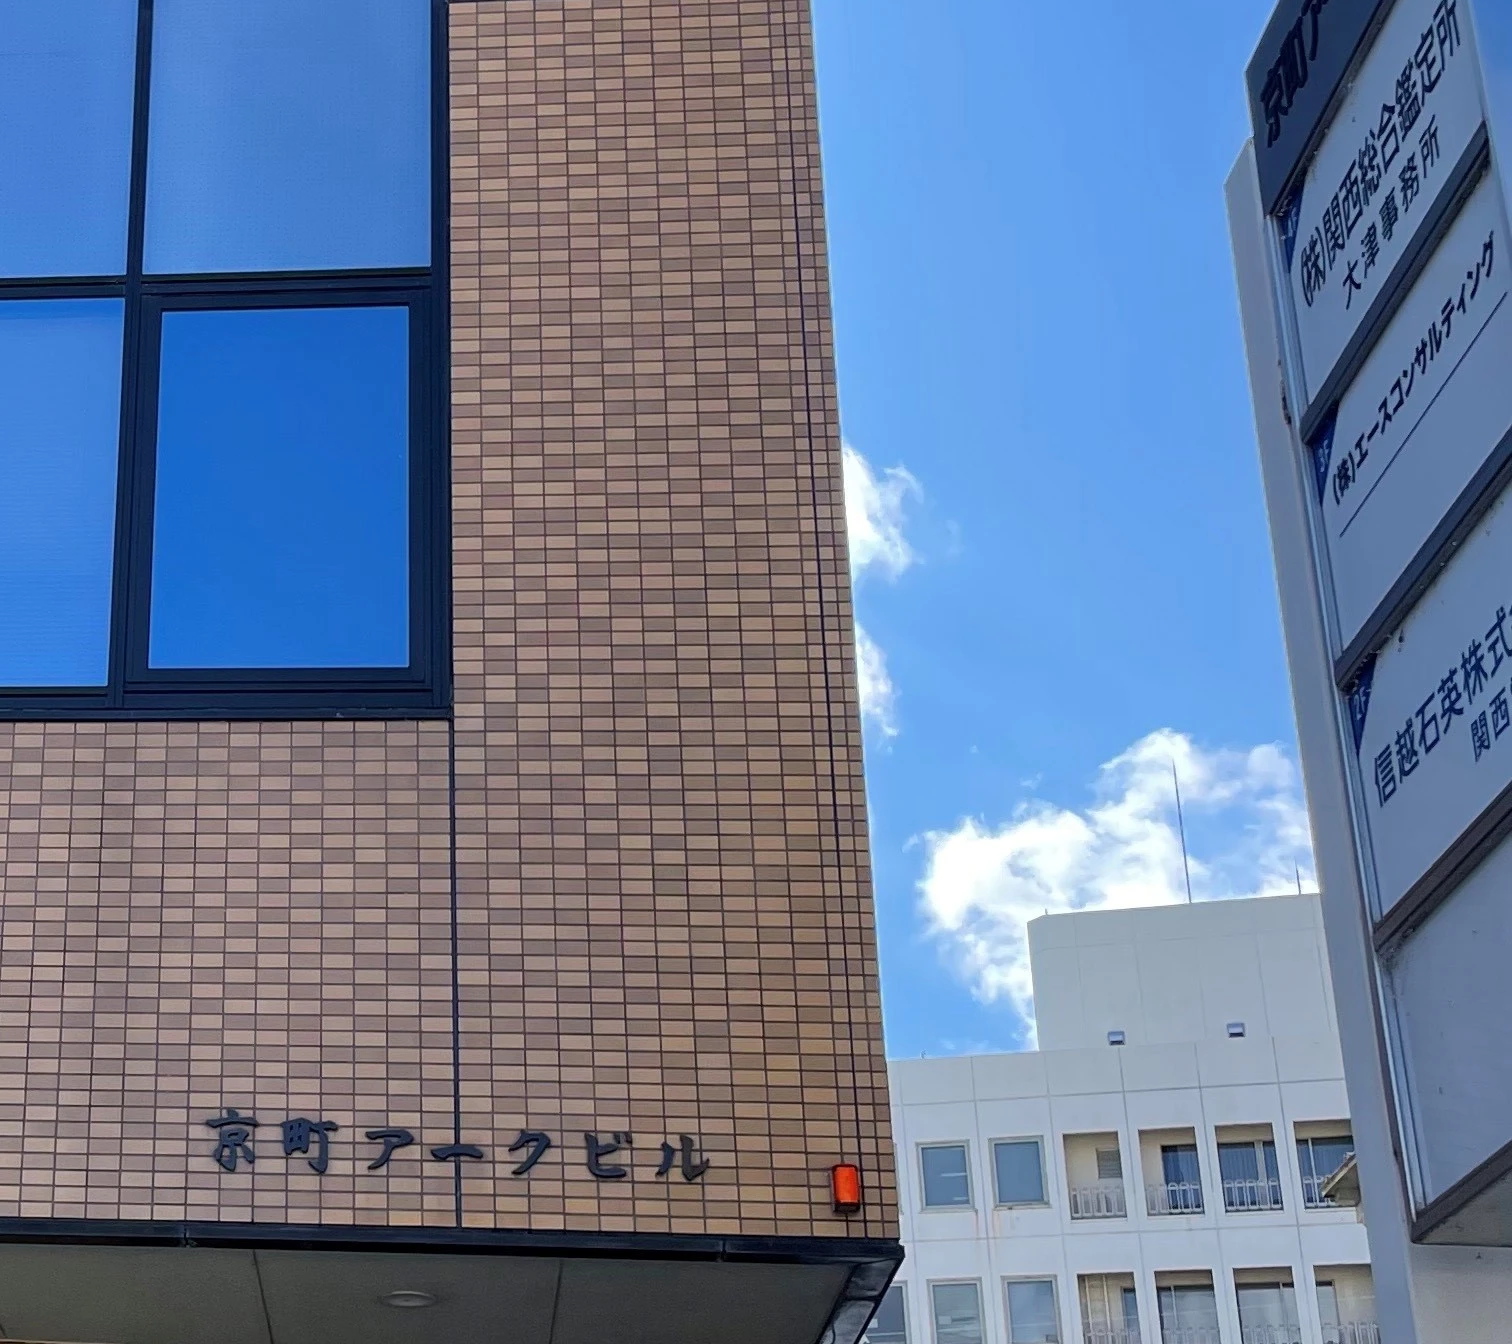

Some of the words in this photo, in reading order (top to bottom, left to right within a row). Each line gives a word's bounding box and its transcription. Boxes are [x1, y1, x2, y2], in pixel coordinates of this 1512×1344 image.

[1343, 114, 1440, 310] 大津事務所
[1374, 605, 1512, 808] 信越石英株式
[1470, 678, 1512, 763] 関西
[205, 1108, 710, 1182] 京町アークビル
